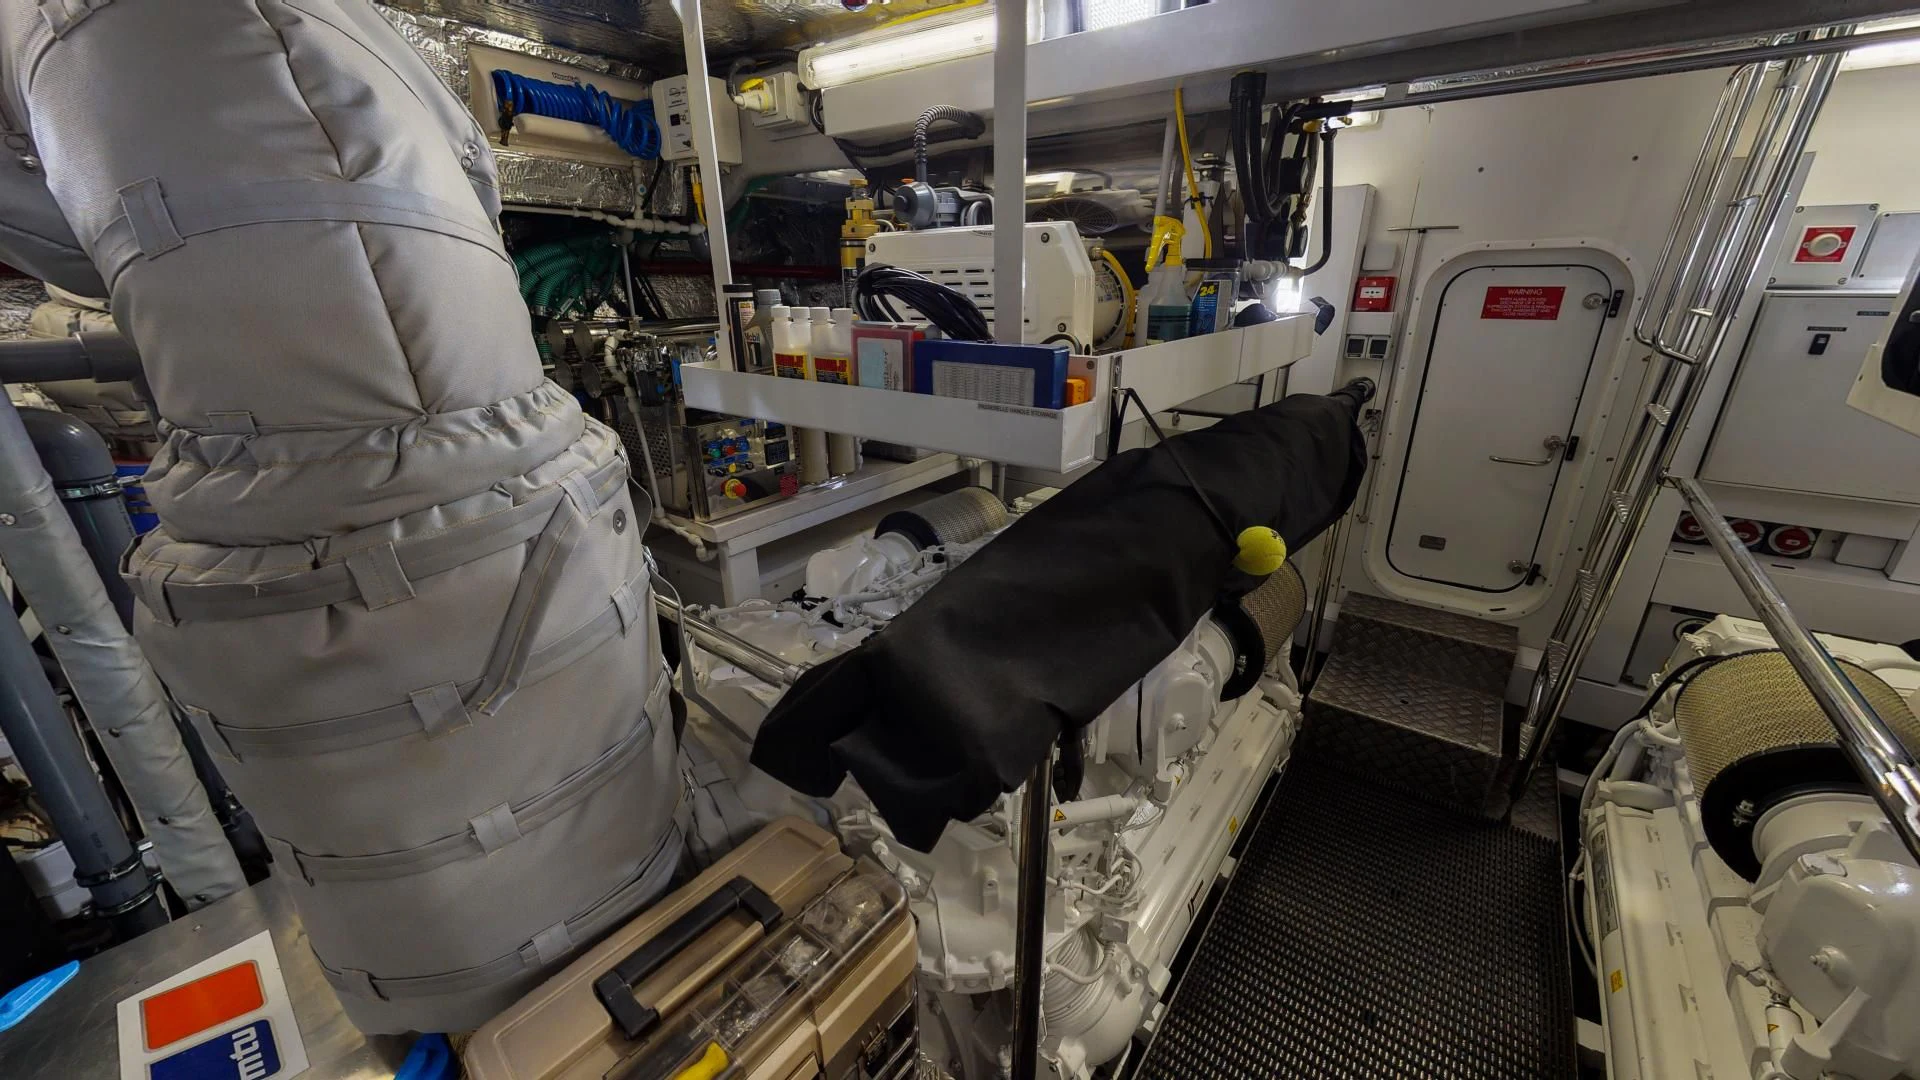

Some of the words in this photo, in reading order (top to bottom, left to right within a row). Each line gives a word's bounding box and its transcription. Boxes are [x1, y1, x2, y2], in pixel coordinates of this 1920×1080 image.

[1199, 285, 1216, 297] 24
[1508, 288, 1543, 296] WARNING
[744, 331, 760, 341] Mobil
[229, 1026, 267, 1080] mtu
